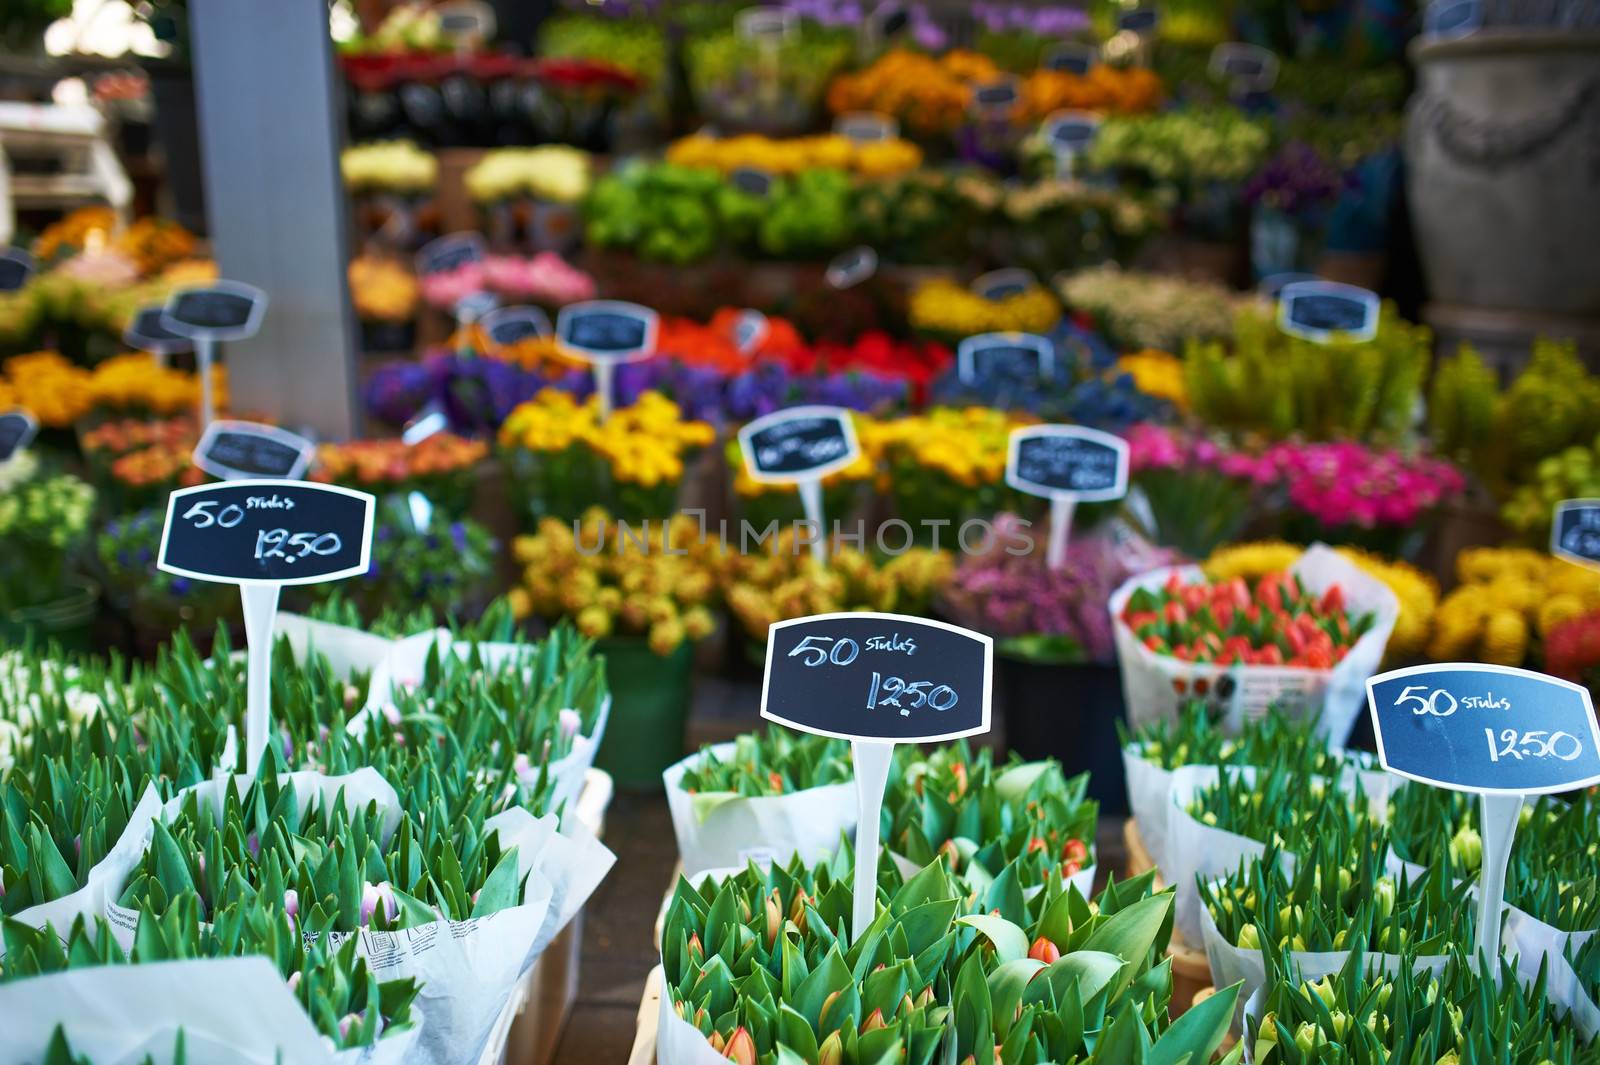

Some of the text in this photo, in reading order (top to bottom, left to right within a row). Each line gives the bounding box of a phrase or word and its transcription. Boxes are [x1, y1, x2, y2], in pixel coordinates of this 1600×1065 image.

[182, 501, 244, 528] 50
[788, 635, 860, 667] 50
[1394, 685, 1458, 716] 50
